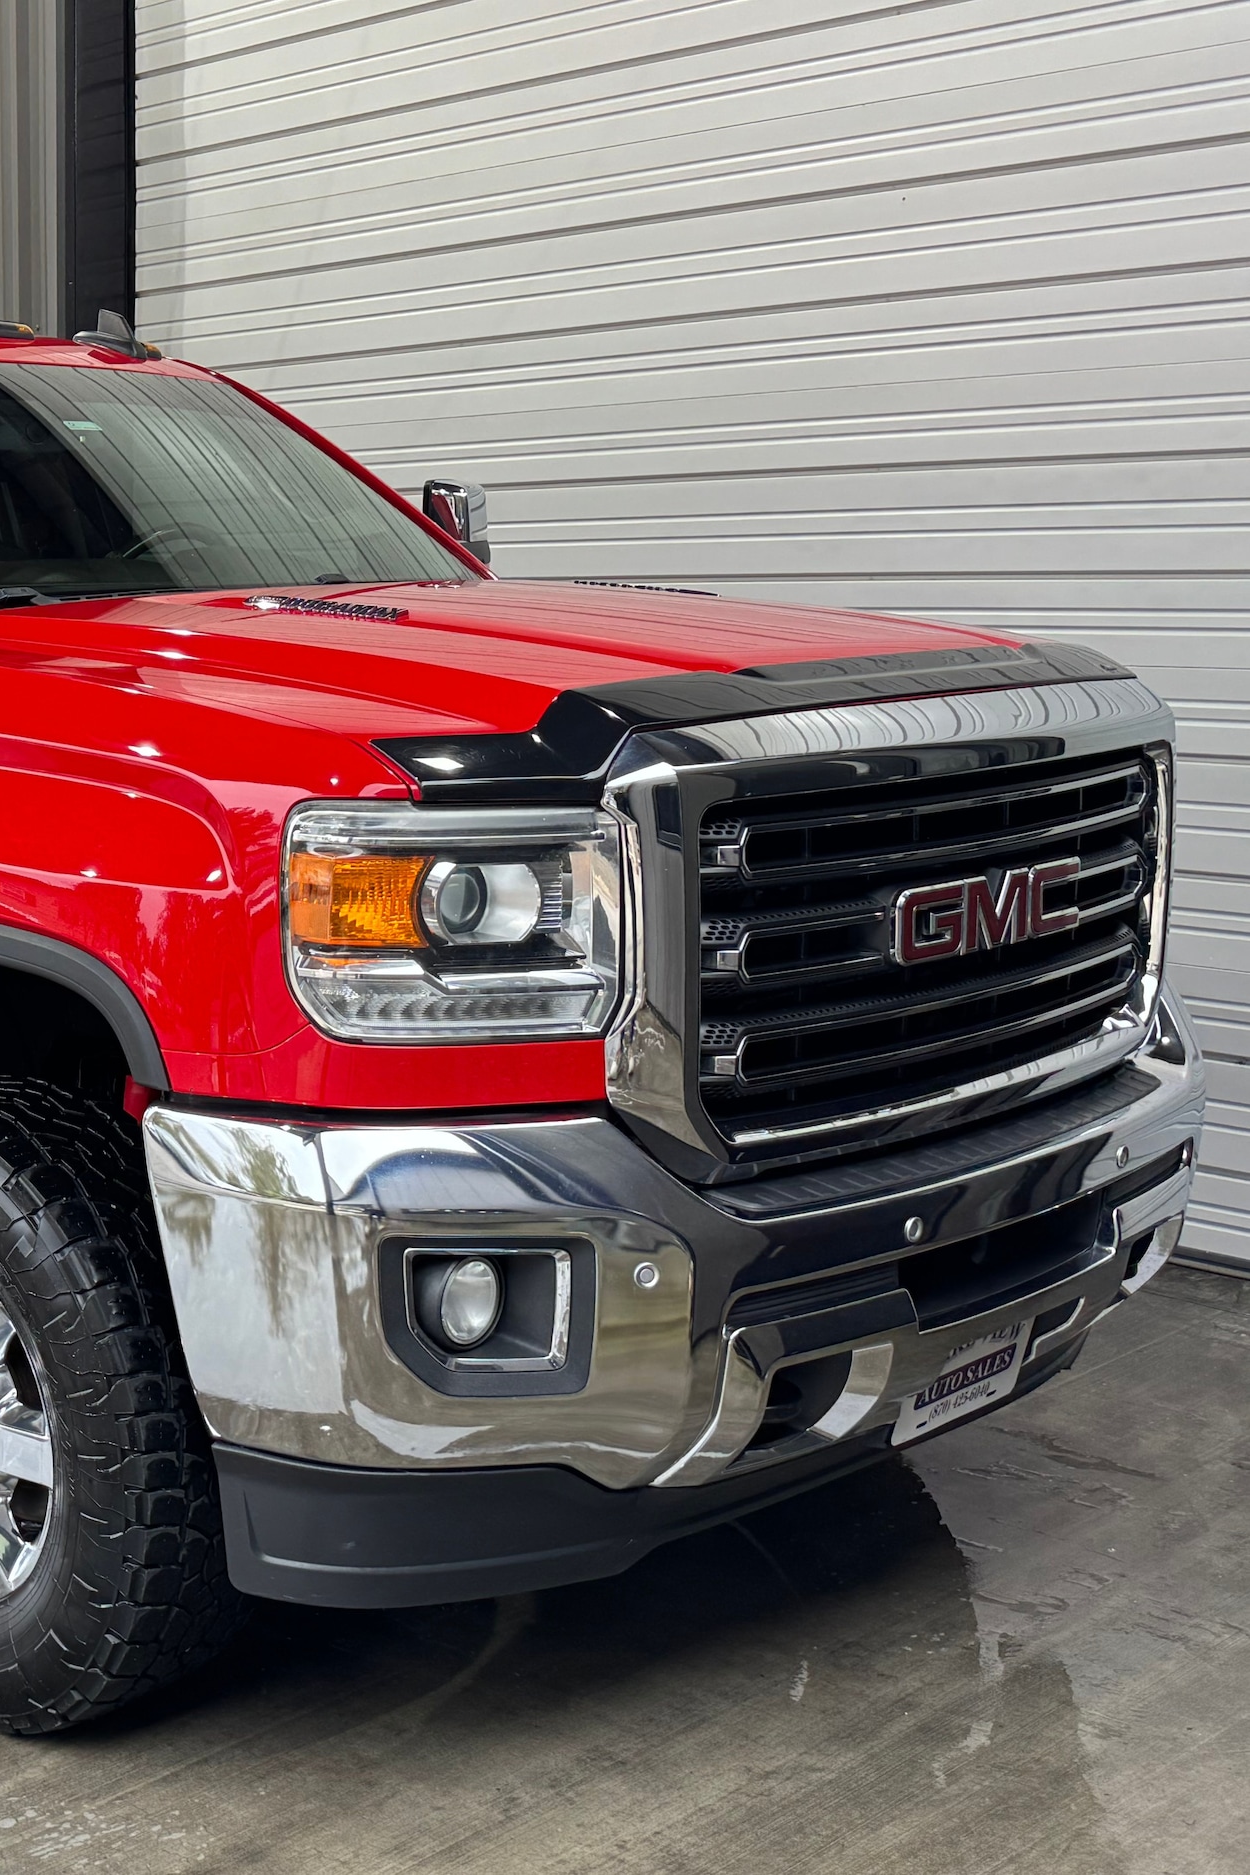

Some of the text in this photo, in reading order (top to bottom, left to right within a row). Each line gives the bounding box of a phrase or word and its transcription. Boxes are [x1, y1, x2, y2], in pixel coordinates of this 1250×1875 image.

[895, 855, 1082, 967] GMC
[918, 1349, 1013, 1406] AUTO SALES
